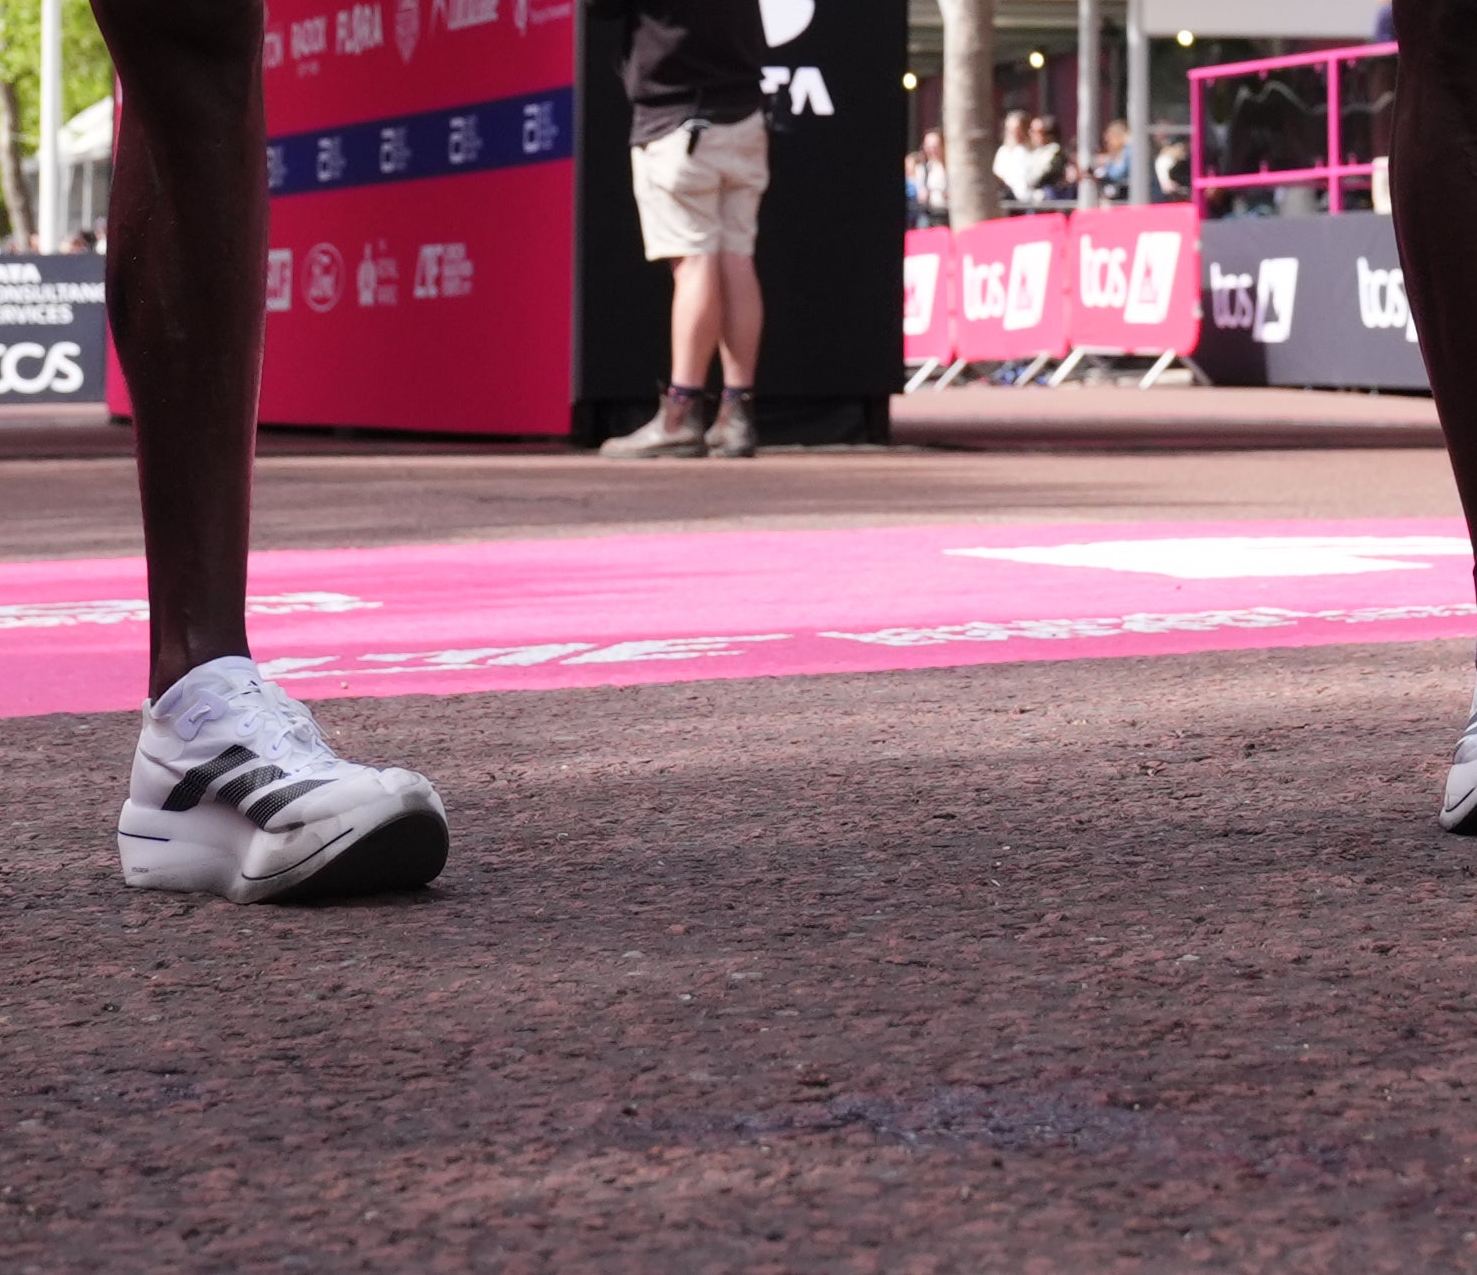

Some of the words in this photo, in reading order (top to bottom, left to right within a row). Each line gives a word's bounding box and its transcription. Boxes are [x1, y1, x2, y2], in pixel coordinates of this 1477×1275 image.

[962, 253, 1009, 322] tcs
[1079, 234, 1128, 309] tcs
[1209, 261, 1254, 331] tcs
